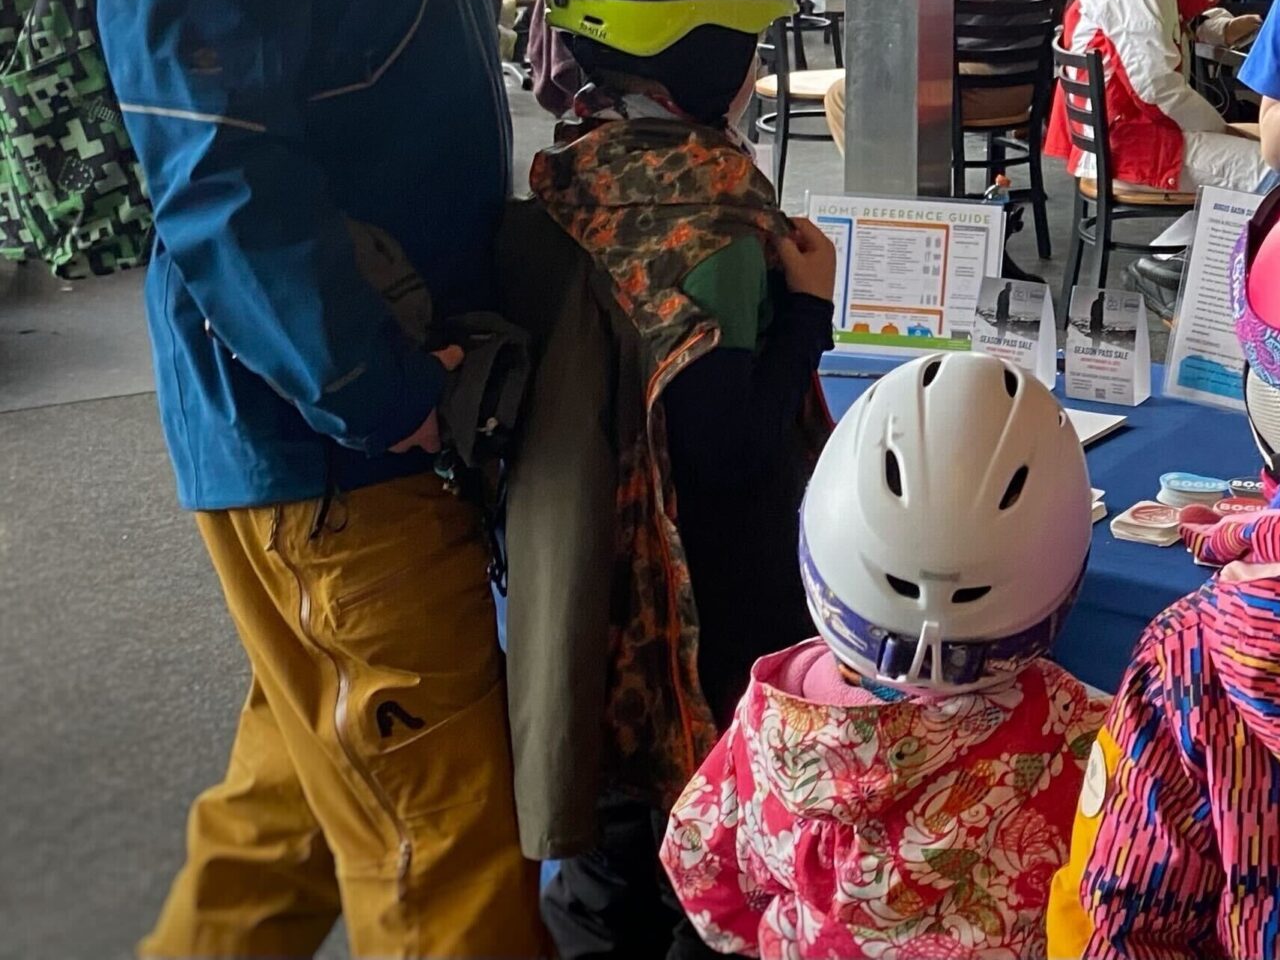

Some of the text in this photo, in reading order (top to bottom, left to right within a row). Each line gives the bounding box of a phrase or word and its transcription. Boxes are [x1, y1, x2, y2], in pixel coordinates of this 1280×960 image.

[818, 205, 857, 216] HOME
[863, 208, 943, 221] REFERENCE
[950, 212, 991, 224] GUIDE
[980, 335, 1033, 351] SEASON PASS SALE
[1074, 346, 1129, 360] SEASON PASS SALE
[1170, 479, 1225, 490] BOGUS
[1232, 480, 1264, 488] BOG
[1219, 502, 1266, 512] BOGU
